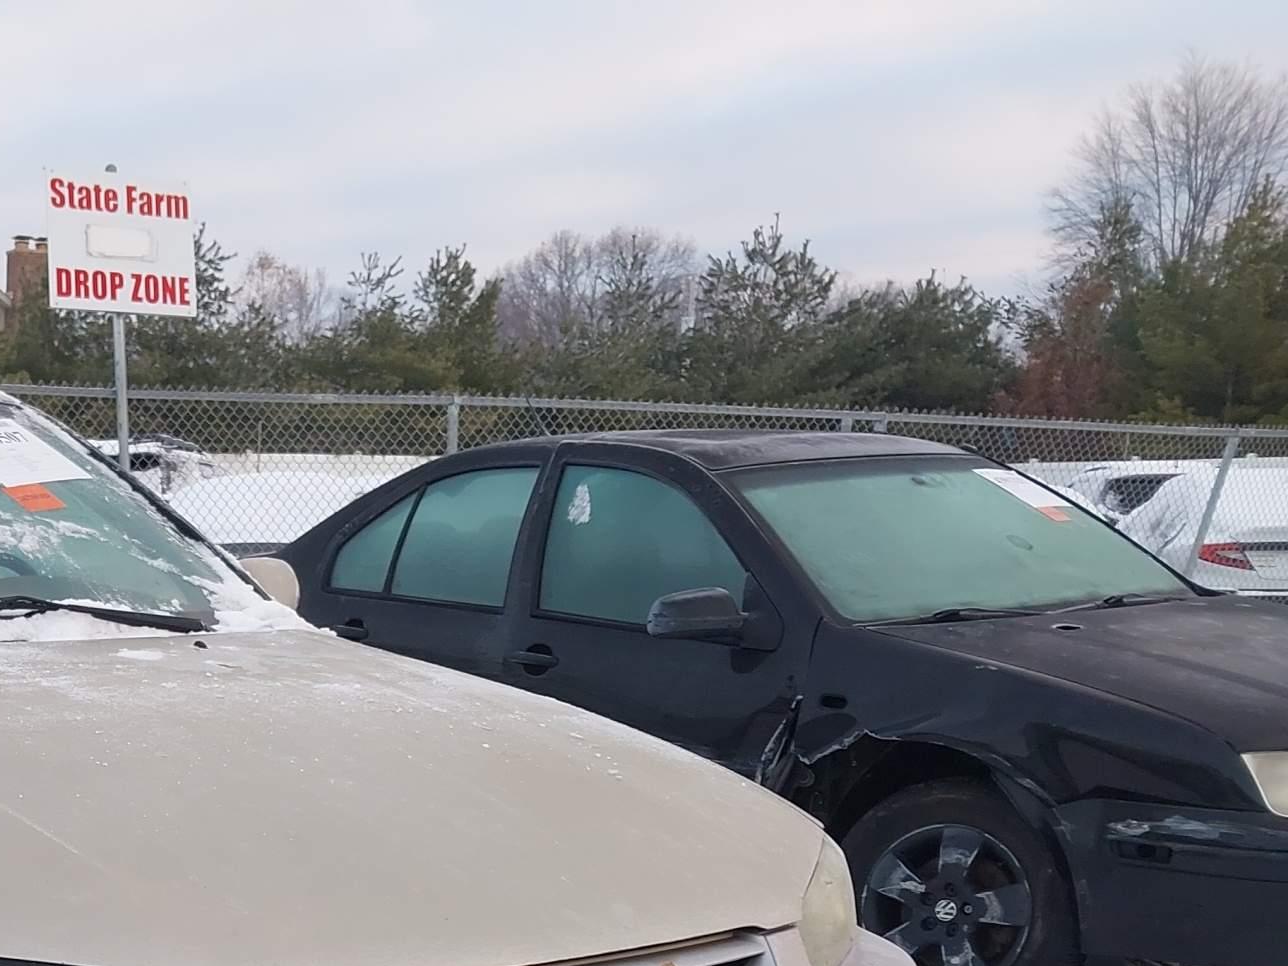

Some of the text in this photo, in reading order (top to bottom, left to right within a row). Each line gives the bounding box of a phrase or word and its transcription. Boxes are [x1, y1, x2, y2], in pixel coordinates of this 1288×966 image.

[49, 178, 189, 219] State Farm
[55, 267, 191, 306] DROP ZONE
